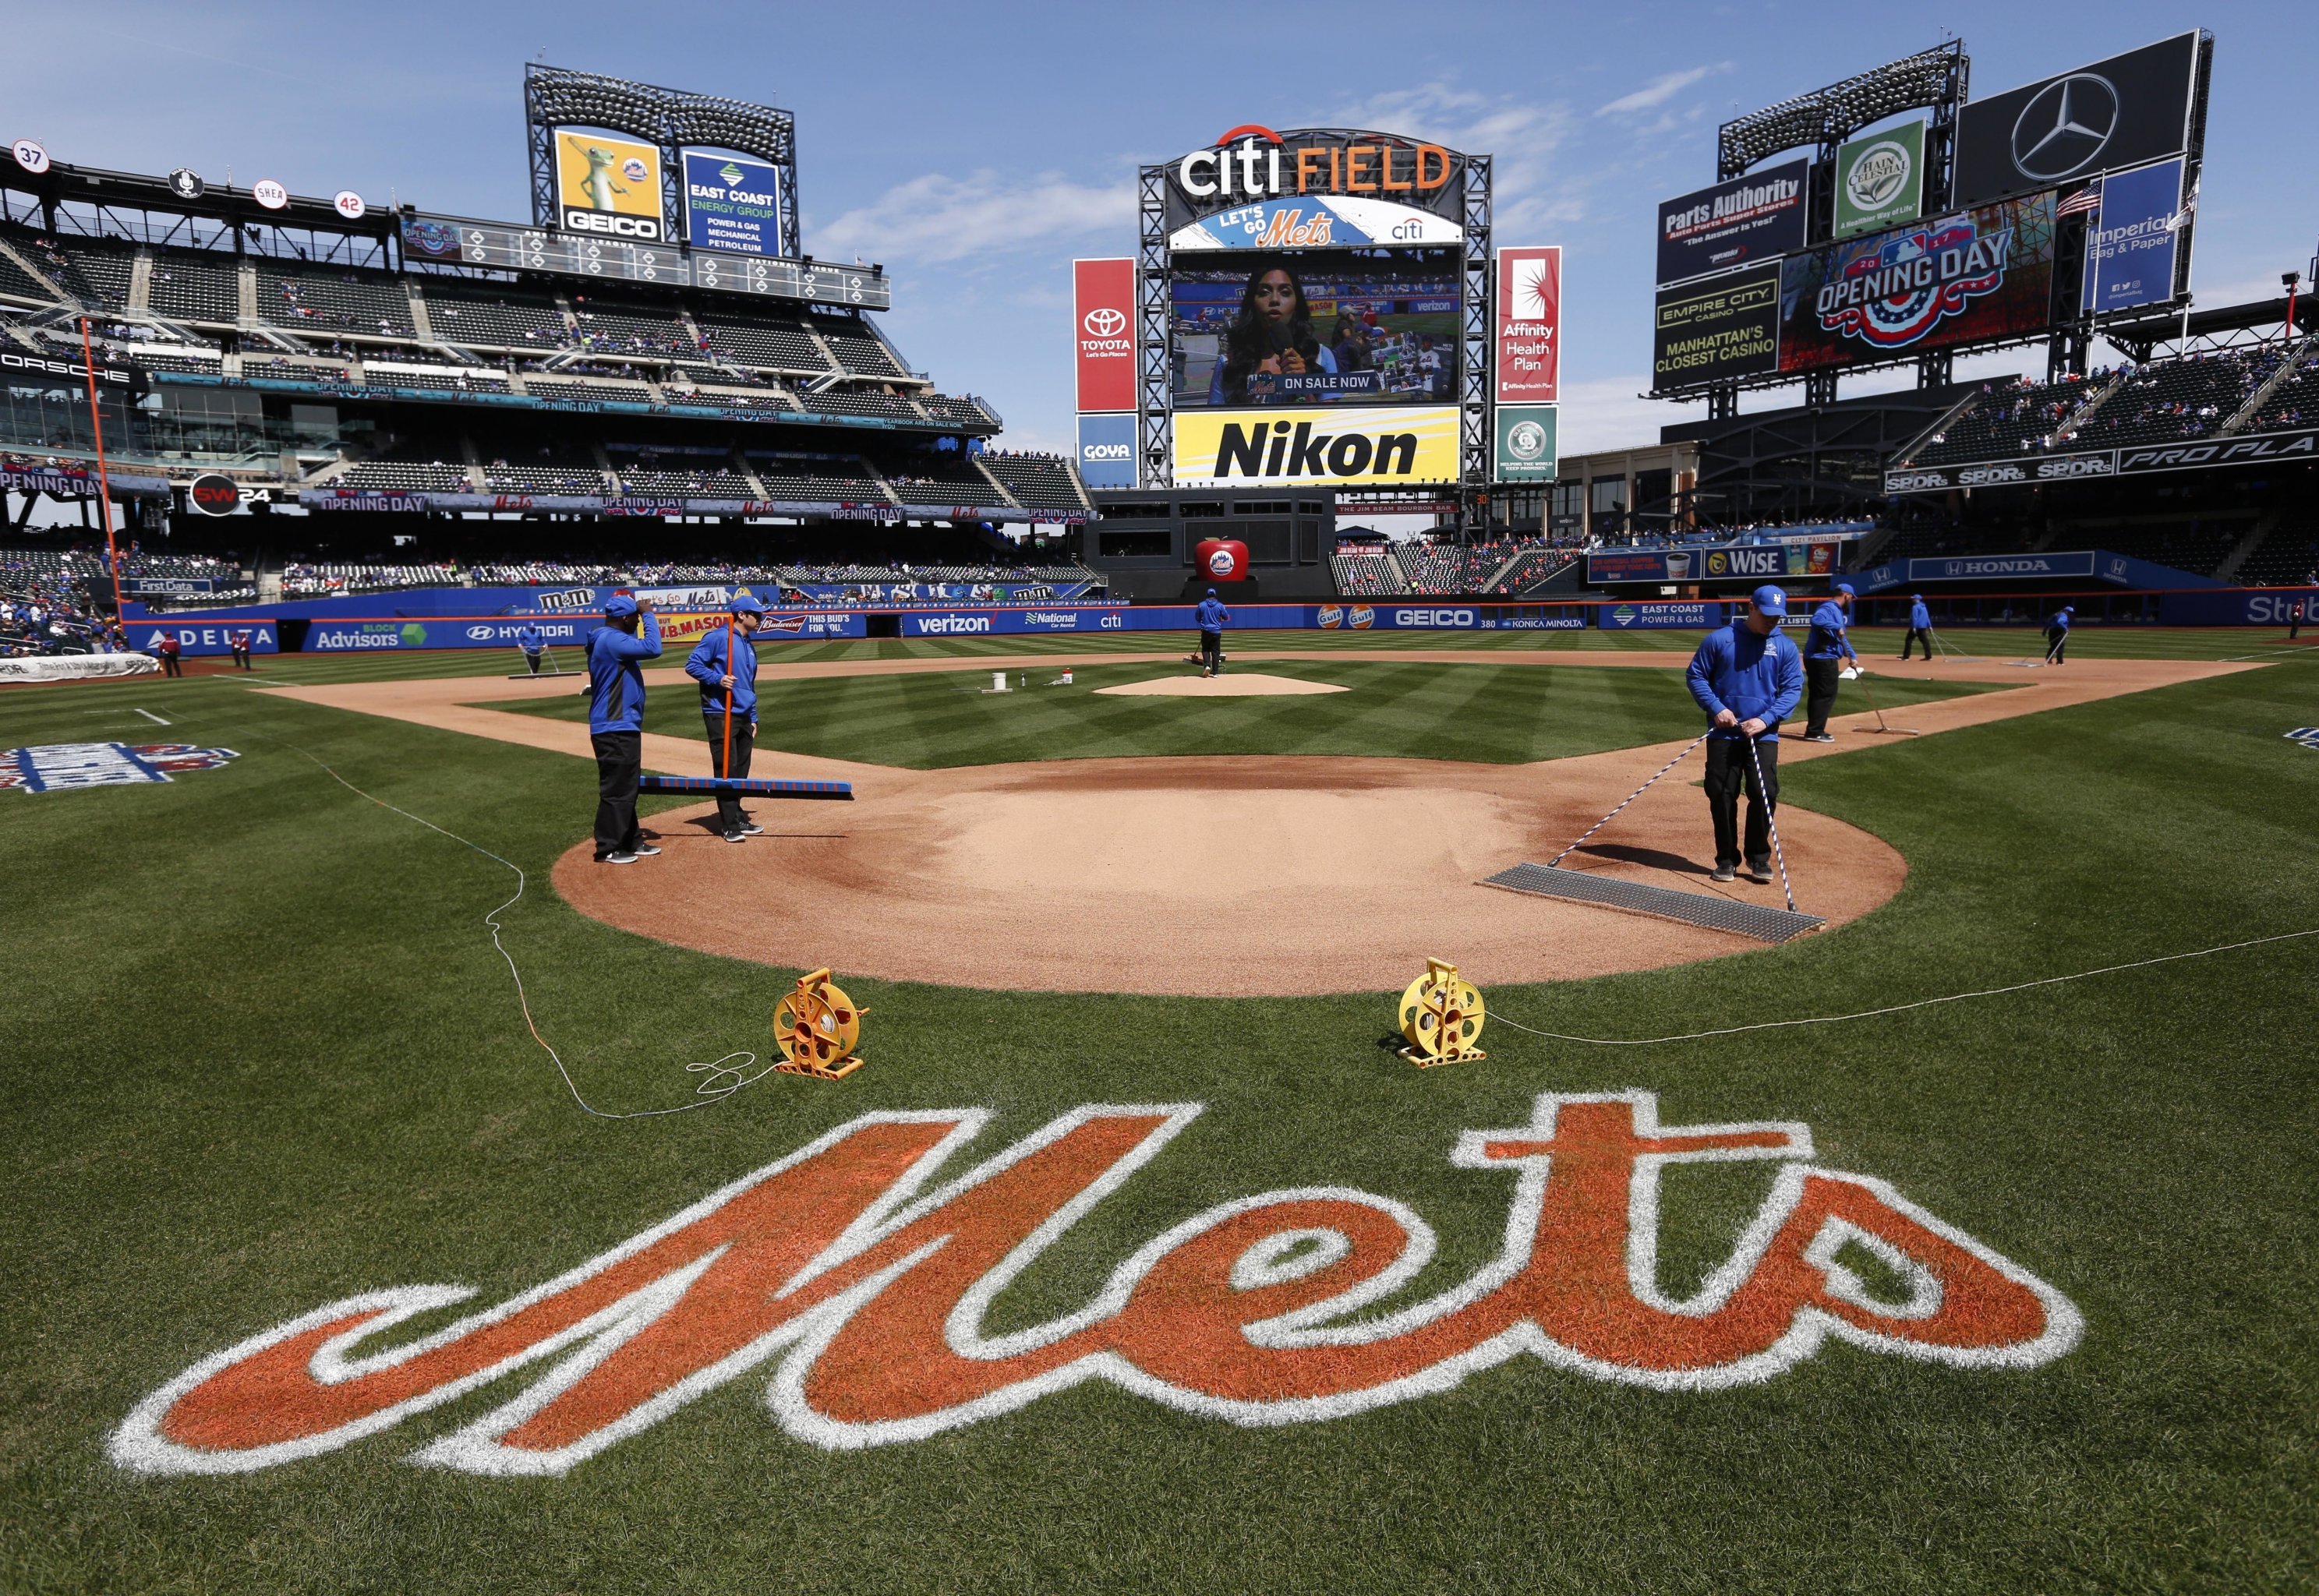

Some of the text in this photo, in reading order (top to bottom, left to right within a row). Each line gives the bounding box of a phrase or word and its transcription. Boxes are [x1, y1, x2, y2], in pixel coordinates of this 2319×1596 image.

[19, 147, 41, 165] 37
[1180, 136, 1451, 195] citi FIELD
[1864, 157, 1894, 173] HAIN
[1848, 160, 1909, 187] CELESTIAL
[258, 188, 283, 200] SHEA
[691, 184, 773, 207] EAST COAST
[340, 197, 359, 211] 42
[691, 200, 774, 219] ENERGY GROUP
[1666, 179, 1799, 233] Parts Authority
[1219, 205, 1264, 228] LET'S
[1669, 199, 1794, 239] Auto Parts Super Stores
[1877, 210, 1891, 220] Way
[1900, 205, 1914, 214] Life
[567, 210, 658, 238] GEICO
[707, 217, 737, 228] POWER
[1244, 219, 1267, 234] GO
[1255, 209, 1334, 247] Mets
[1391, 221, 1423, 239] citi
[2089, 212, 2172, 245] Imperial
[405, 228, 442, 241] OPENING
[708, 228, 762, 242] MECHANICAL
[1705, 227, 1739, 240] Answer
[1741, 223, 1750, 231] Is
[592, 238, 635, 249] LEAGUE
[709, 239, 762, 252] PETROLEUM
[1933, 234, 1950, 248] 17
[2118, 242, 2127, 254] &
[2130, 234, 2170, 251] Paper
[748, 258, 797, 269] NATIONAL
[1860, 260, 1875, 268] 20
[1817, 234, 2008, 313] OPENING DAY
[1417, 300, 1451, 311] verizon
[1663, 288, 1769, 321] EMPIRE CITY
[1695, 308, 1734, 323] CASINO
[1503, 323, 1554, 340] Affinity
[1080, 340, 1131, 351] TOYOTA
[1507, 341, 1550, 355] Health
[1667, 325, 1764, 357] MANHATTAN'S
[1514, 357, 1541, 370] Plan
[1656, 339, 1774, 373] CLOSEST CASINO
[1285, 376, 1370, 389] ON SALE NOW
[533, 401, 601, 412] OPENING DAY
[1083, 444, 1131, 459] GOYA
[1214, 421, 1418, 478] Nikon
[2122, 436, 2319, 468] PRO PLA
[72, 479, 104, 494] DAY
[238, 489, 271, 503] 24
[493, 494, 532, 511] Mets
[323, 497, 424, 512] OPENING DAY
[742, 500, 774, 516] Mets
[831, 507, 904, 520] OPENING DAY
[952, 507, 979, 520] Mets
[1729, 550, 1779, 574] WISE
[1965, 560, 2051, 574] HONDA
[1869, 578, 1898, 590] HONDA
[2103, 572, 2127, 583] HONDA
[140, 581, 193, 591] First Data
[666, 589, 716, 606] Go Mets
[1319, 610, 1342, 622] Gulf
[1642, 605, 1705, 614] EAST COAST
[762, 620, 802, 628] Budweiser
[827, 614, 850, 623] BUD'S
[918, 613, 990, 633] verizon
[1038, 613, 1077, 623] National
[1101, 613, 1122, 628] citi
[1350, 612, 1373, 623] Gulf
[1395, 609, 1474, 627] GEICO
[1481, 620, 1496, 628] 380
[1512, 620, 1545, 628] KONICA
[1685, 615, 1705, 623] GAS
[363, 624, 396, 633] BLOCK
[500, 625, 574, 637] HYNDAI
[316, 633, 398, 648] Advisors
[107, 1089, 2086, 1480] Mets
